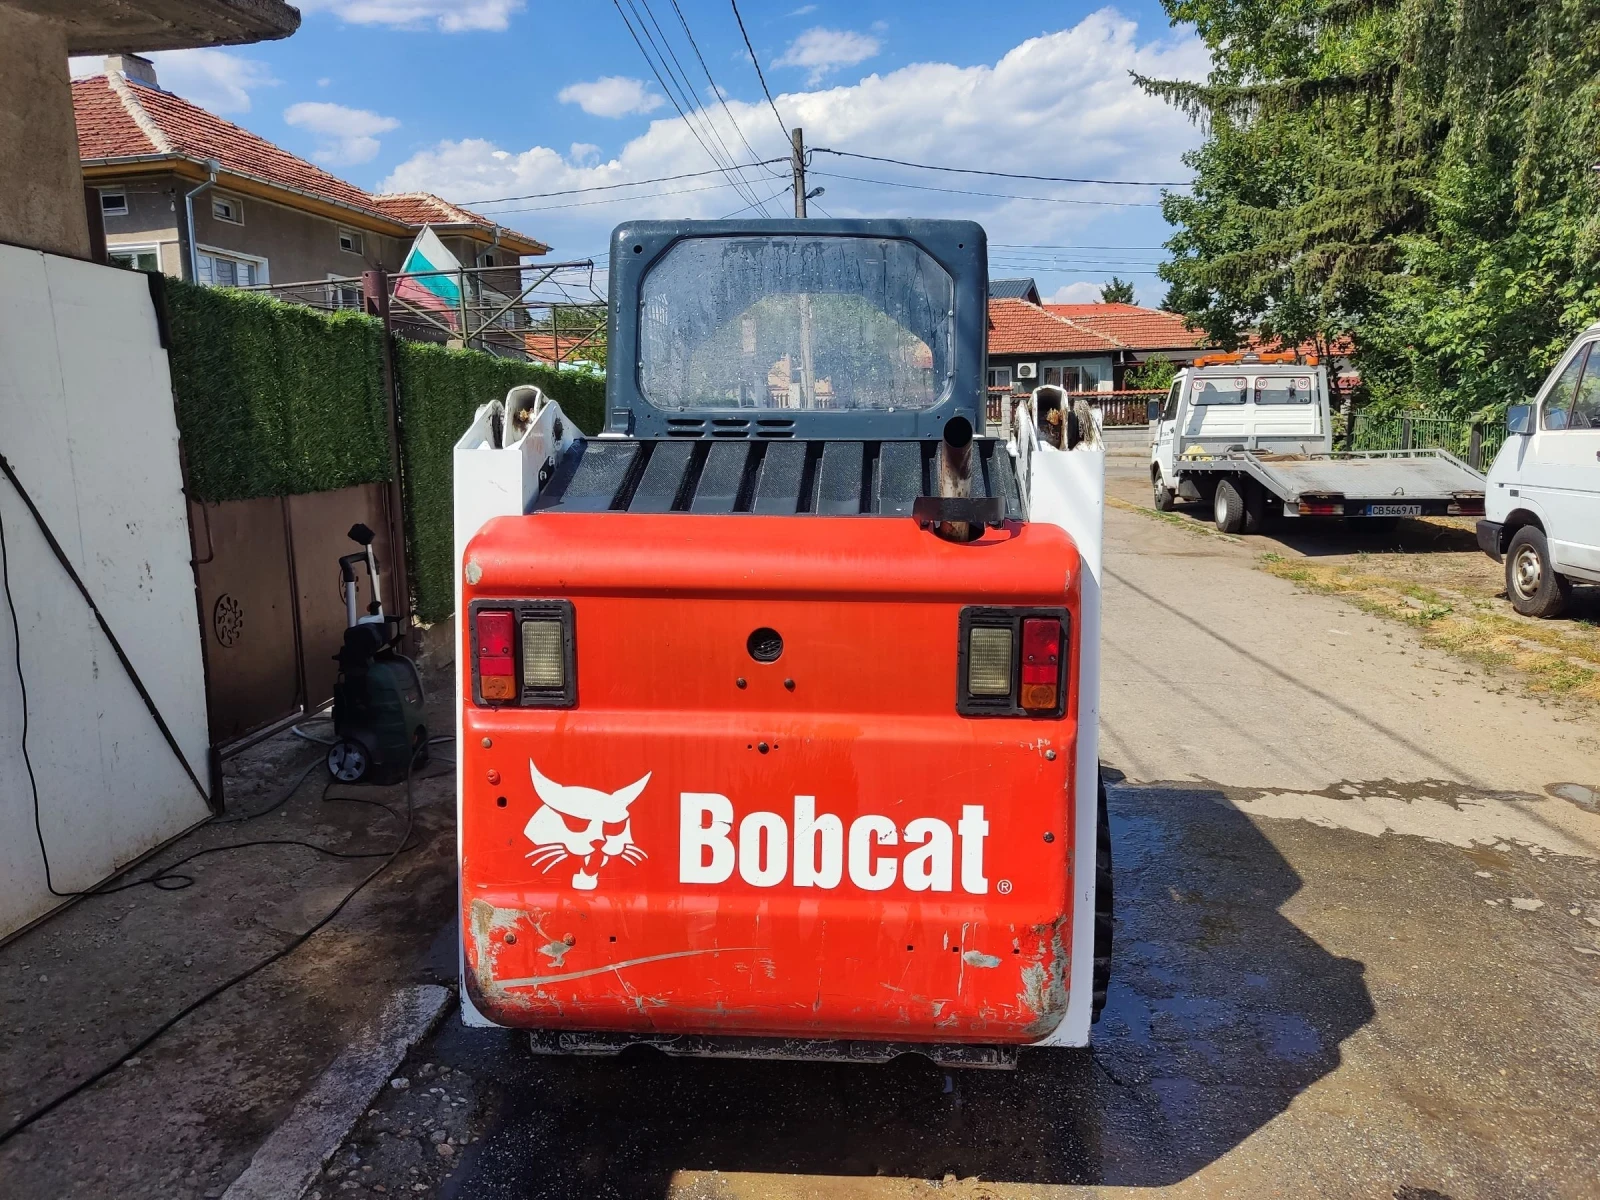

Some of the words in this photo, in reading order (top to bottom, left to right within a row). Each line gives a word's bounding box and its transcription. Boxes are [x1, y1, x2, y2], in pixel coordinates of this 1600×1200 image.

[1372, 506, 1384, 515] CB
[1385, 506, 1407, 515] 5669
[1408, 506, 1420, 515] AT
[679, 792, 989, 895] Bobcat
